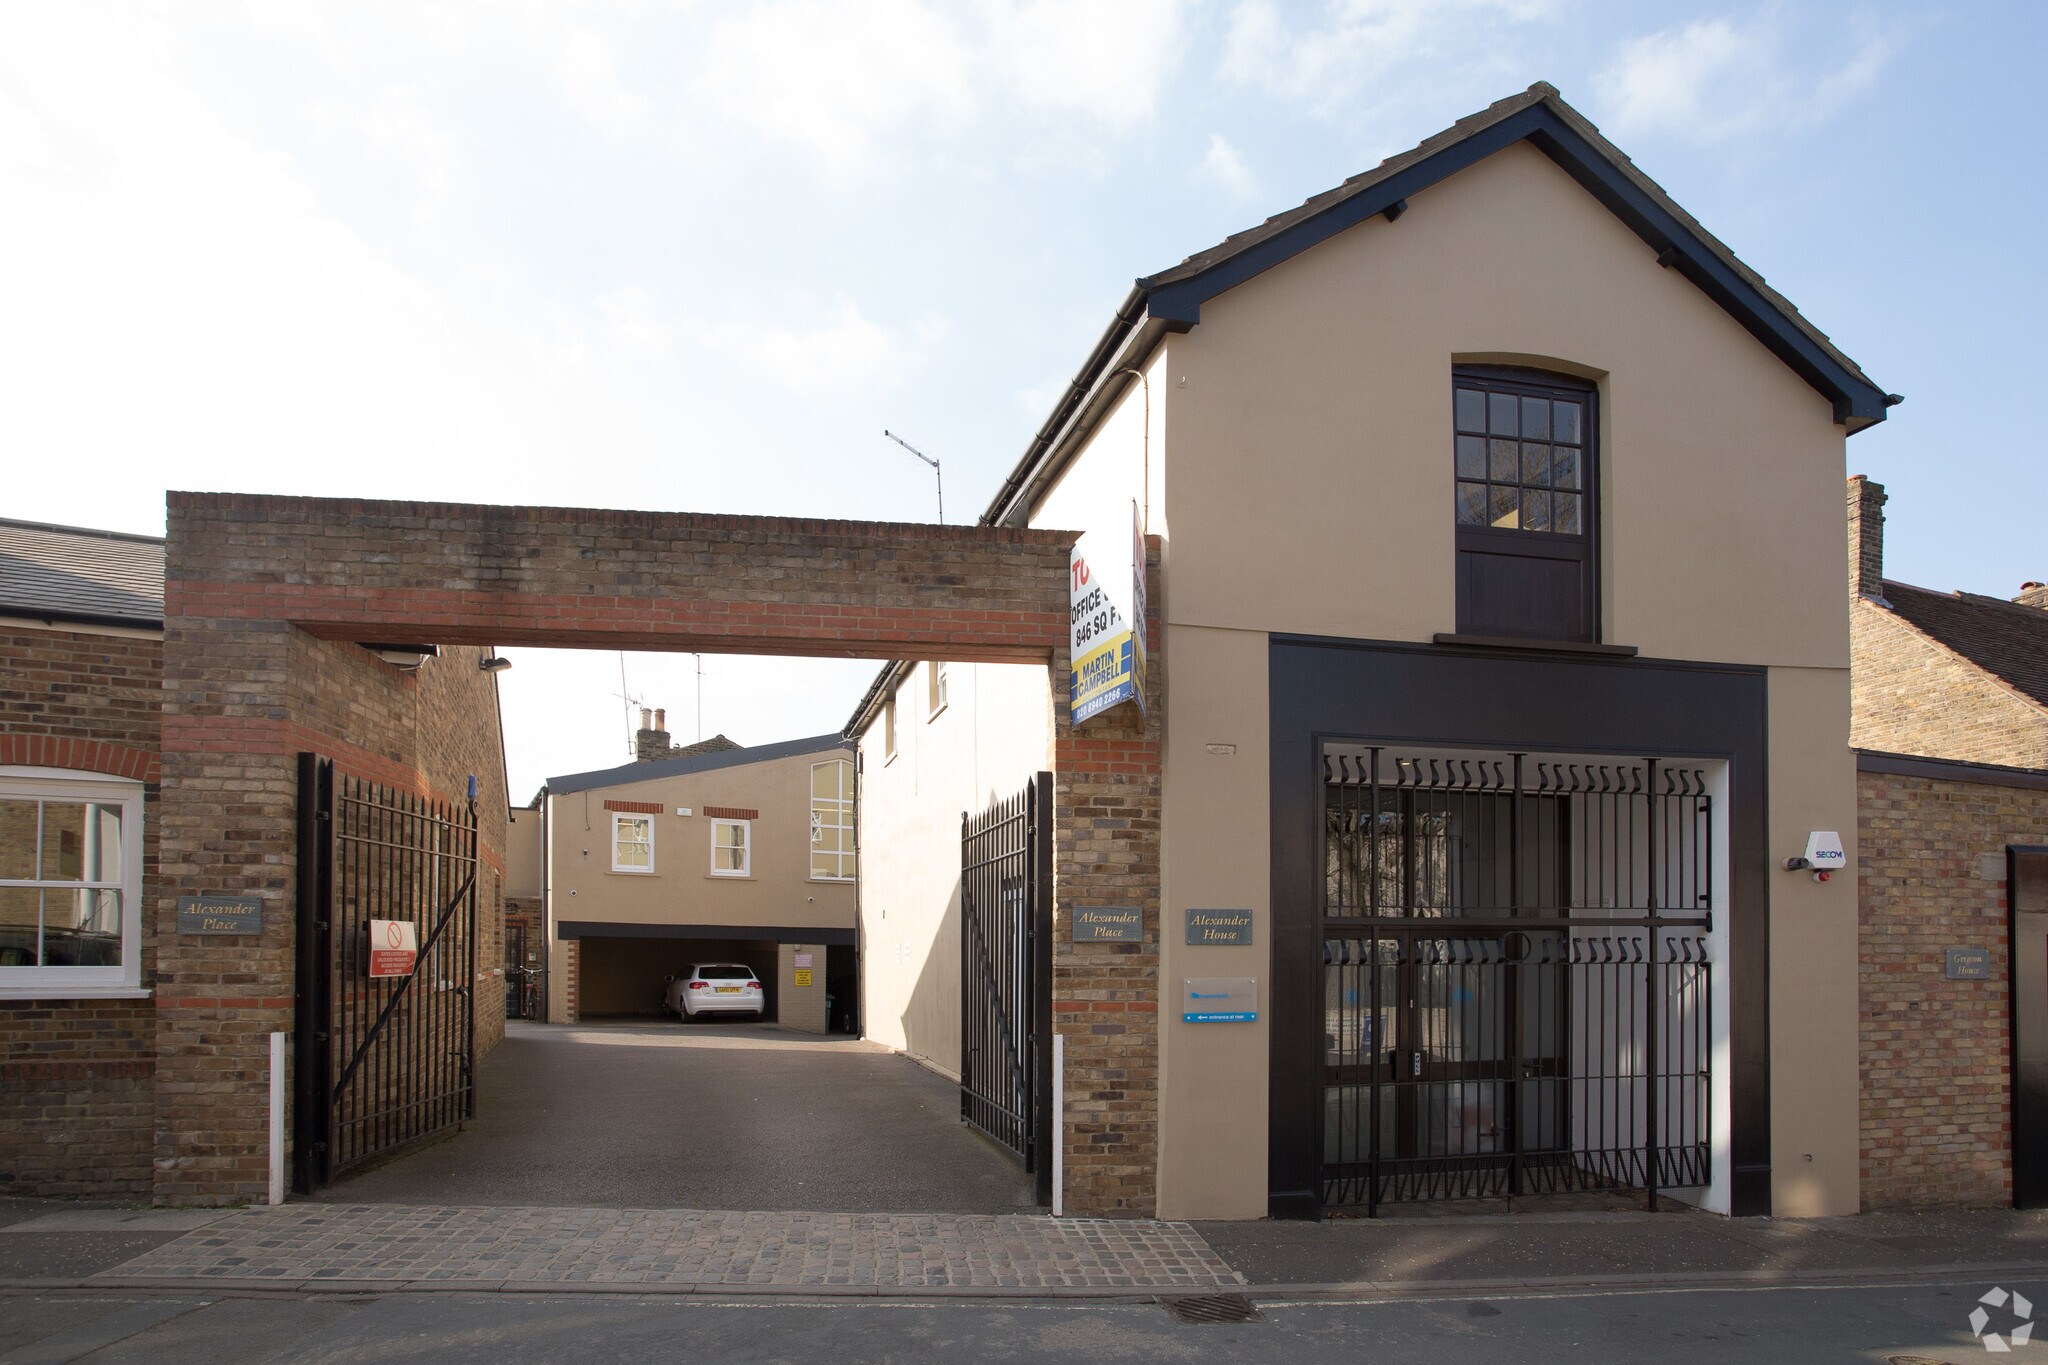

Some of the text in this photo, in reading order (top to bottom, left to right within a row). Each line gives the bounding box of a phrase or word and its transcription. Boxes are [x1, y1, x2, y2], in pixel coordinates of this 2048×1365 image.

[1072, 587, 1101, 625] OFFICE
[1076, 621, 1091, 647] 846
[1093, 611, 1107, 636] SQ
[1082, 648, 1114, 680] MARTIN
[1079, 662, 1119, 697] CAMPBELL
[1077, 705, 1087, 719] 020
[1087, 696, 1103, 713] 8940
[1104, 688, 1120, 705] 2266
[184, 902, 256, 914] Alexander
[1078, 911, 1138, 923] Alexander
[1190, 914, 1250, 926] Alexander
[202, 918, 237, 930] Place
[1094, 926, 1123, 937] Place
[1204, 928, 1237, 940] House
[1957, 965, 1980, 975] House
